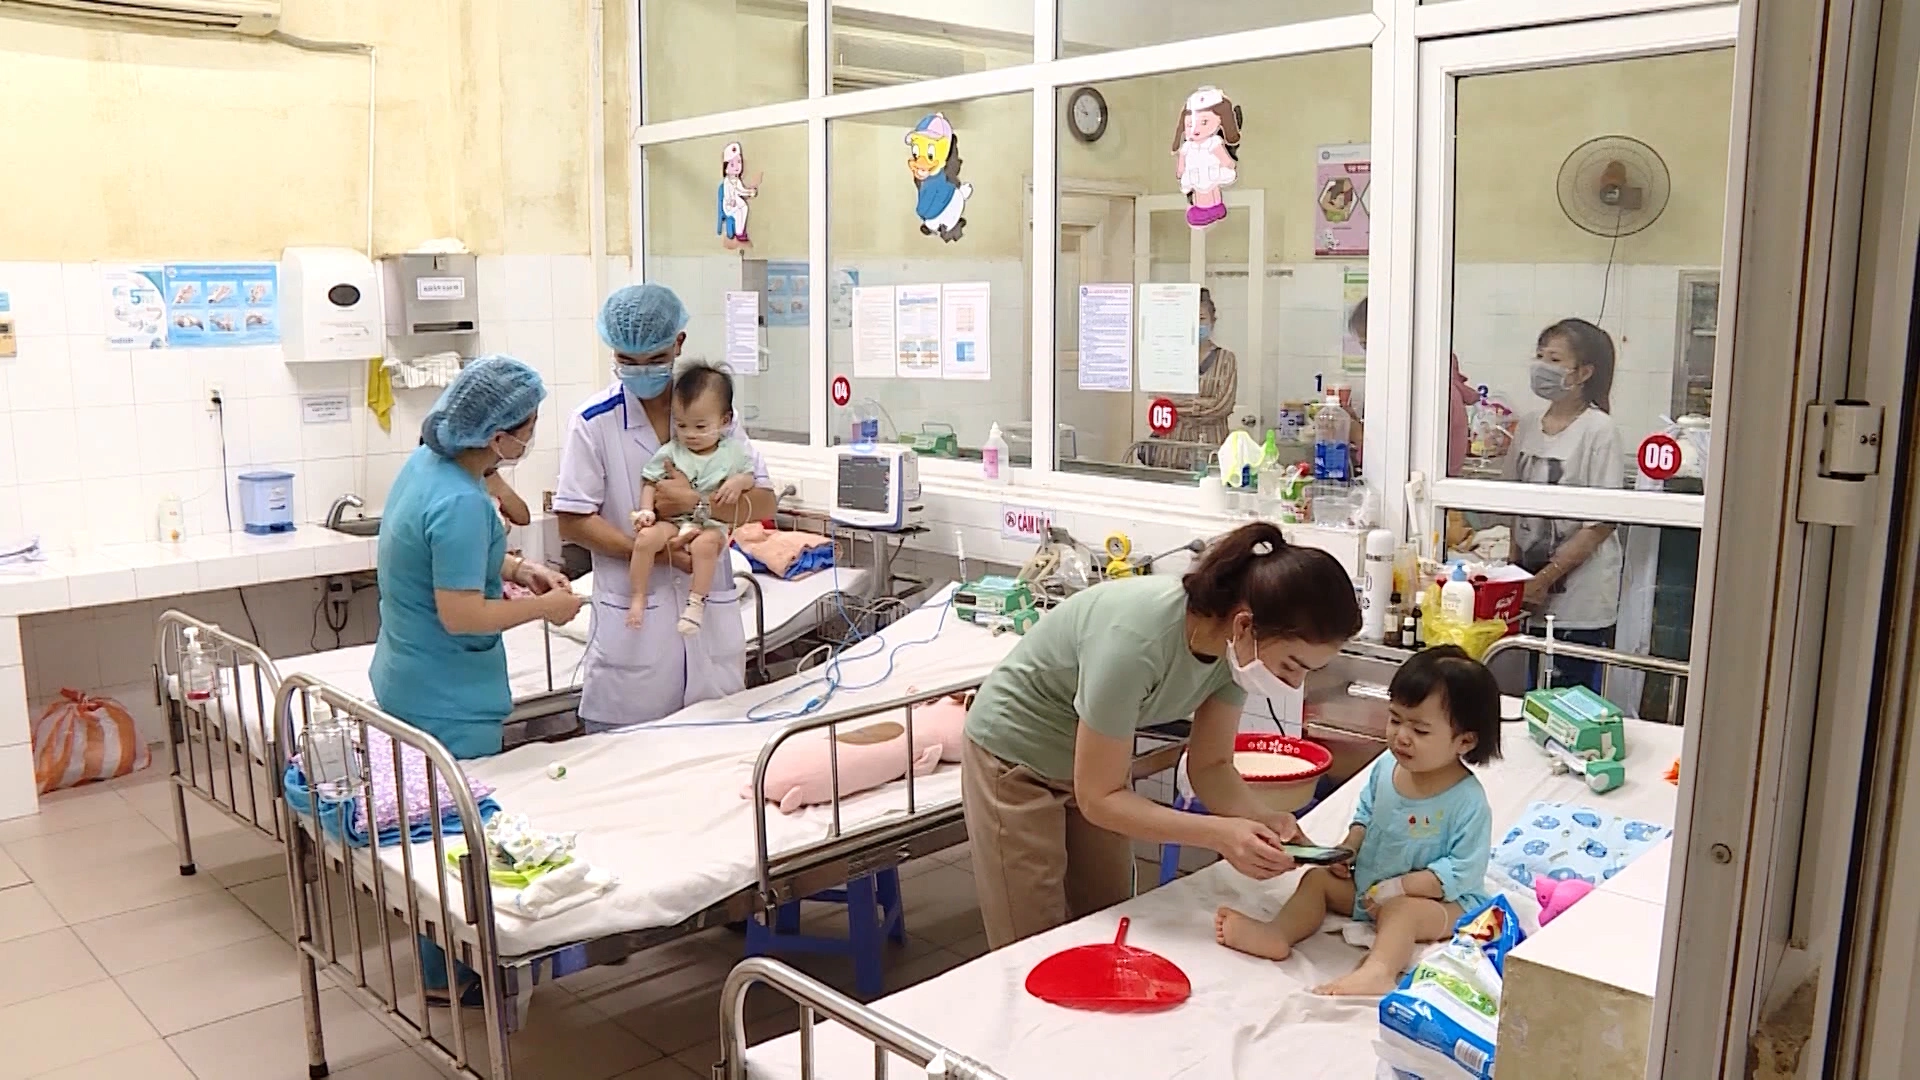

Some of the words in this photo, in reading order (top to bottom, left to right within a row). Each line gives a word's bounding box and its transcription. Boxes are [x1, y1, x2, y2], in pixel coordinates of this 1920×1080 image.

[834, 381, 848, 400] 04
[1314, 373, 1322, 392] 1
[1152, 405, 1172, 429] 05
[1644, 442, 1674, 470] 06
